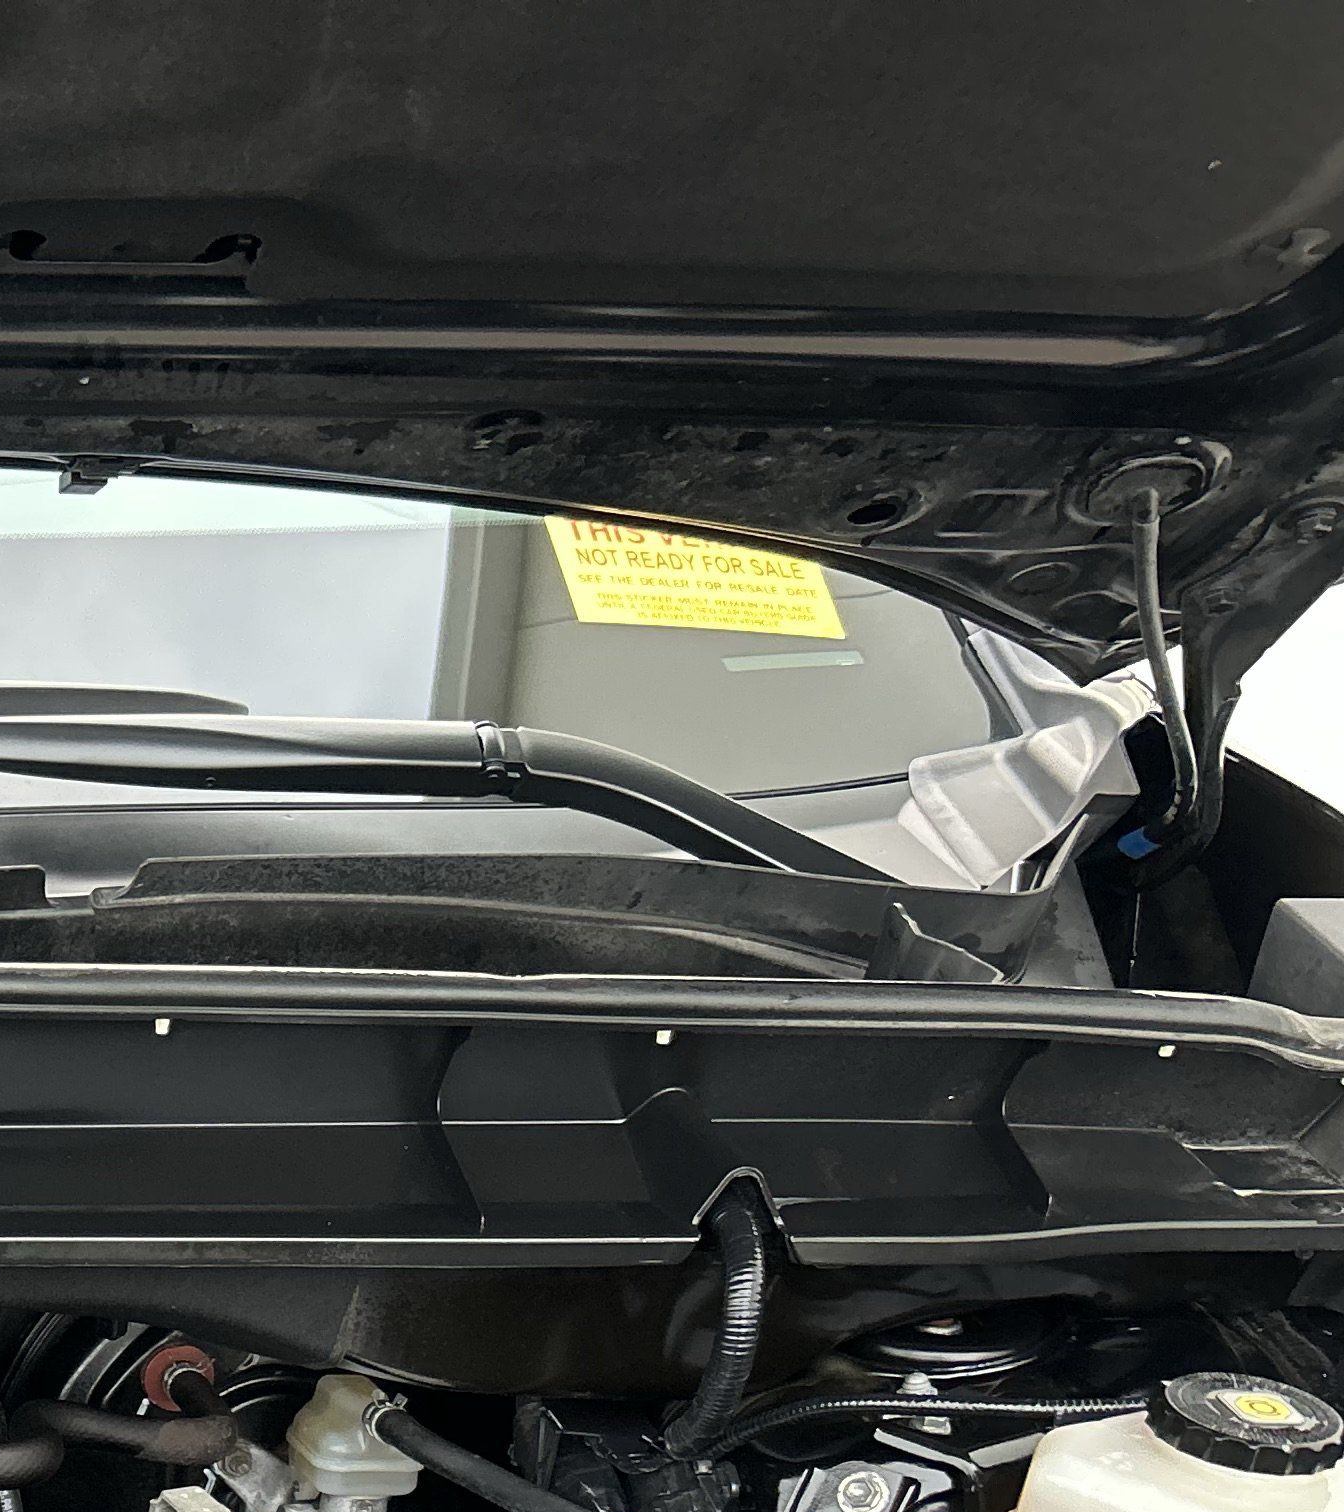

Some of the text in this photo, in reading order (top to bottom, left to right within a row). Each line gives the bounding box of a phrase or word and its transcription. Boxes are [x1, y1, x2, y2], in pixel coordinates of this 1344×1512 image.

[576, 548, 806, 580] NOT READY FOR SALE
[578, 574, 602, 583] SEE
[610, 575, 633, 585] THE
[640, 576, 689, 588] DEALER
[697, 580, 722, 590] FOR
